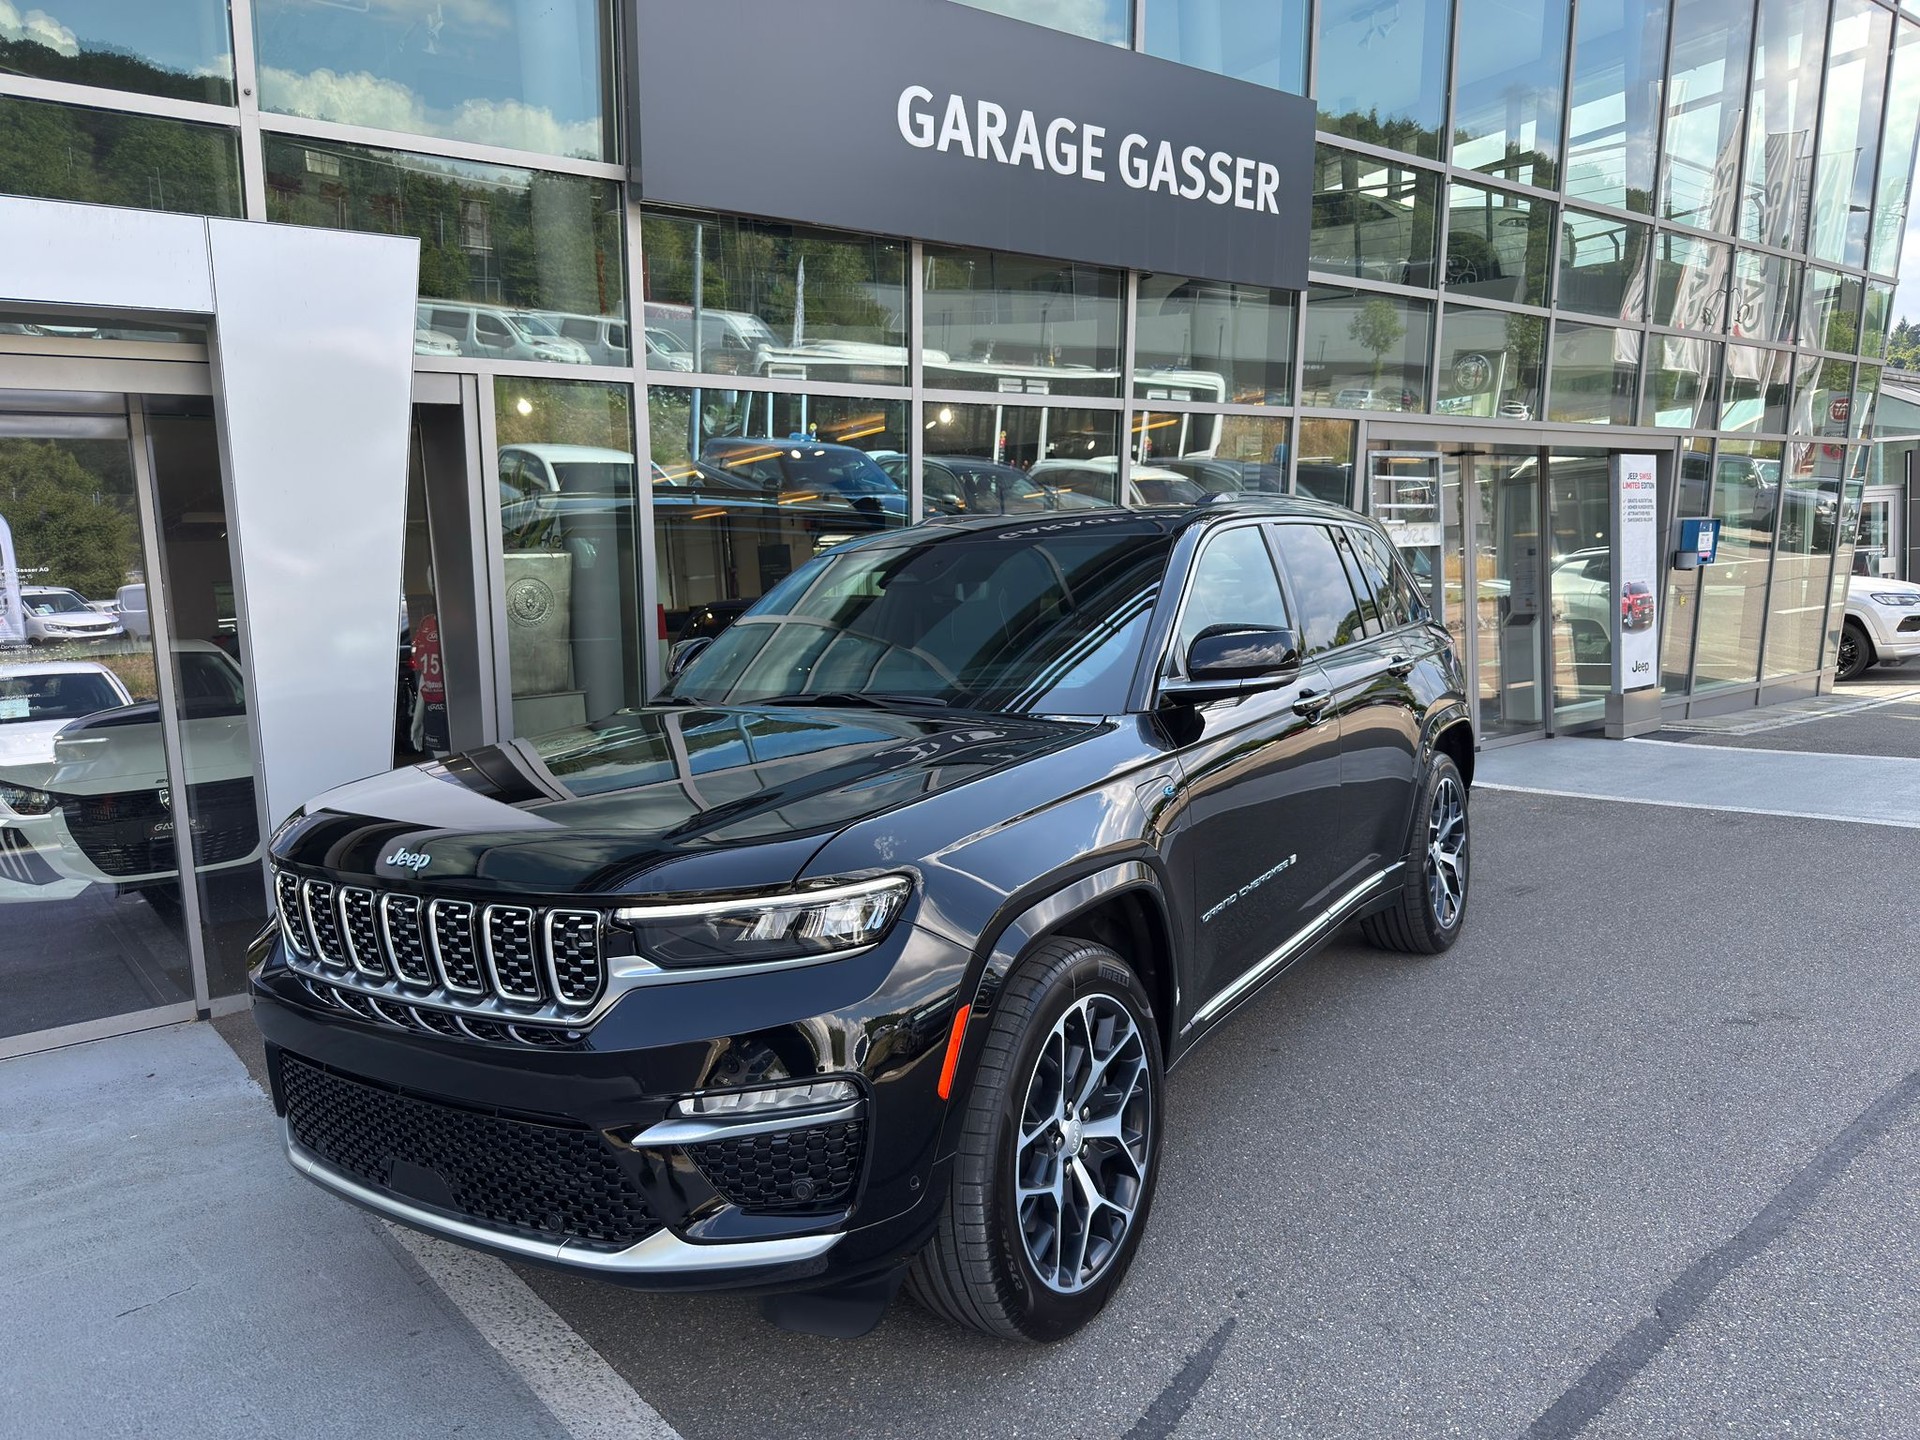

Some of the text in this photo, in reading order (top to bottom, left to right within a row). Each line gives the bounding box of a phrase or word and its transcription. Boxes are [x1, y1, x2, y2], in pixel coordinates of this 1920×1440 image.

[897, 85, 1280, 215] GARAGE GASSER
[420, 653, 440, 675] 15
[1632, 660, 1650, 673] Jeep
[386, 847, 431, 872] Jeep
[1201, 859, 1289, 923] GRAND CHEROKEE
